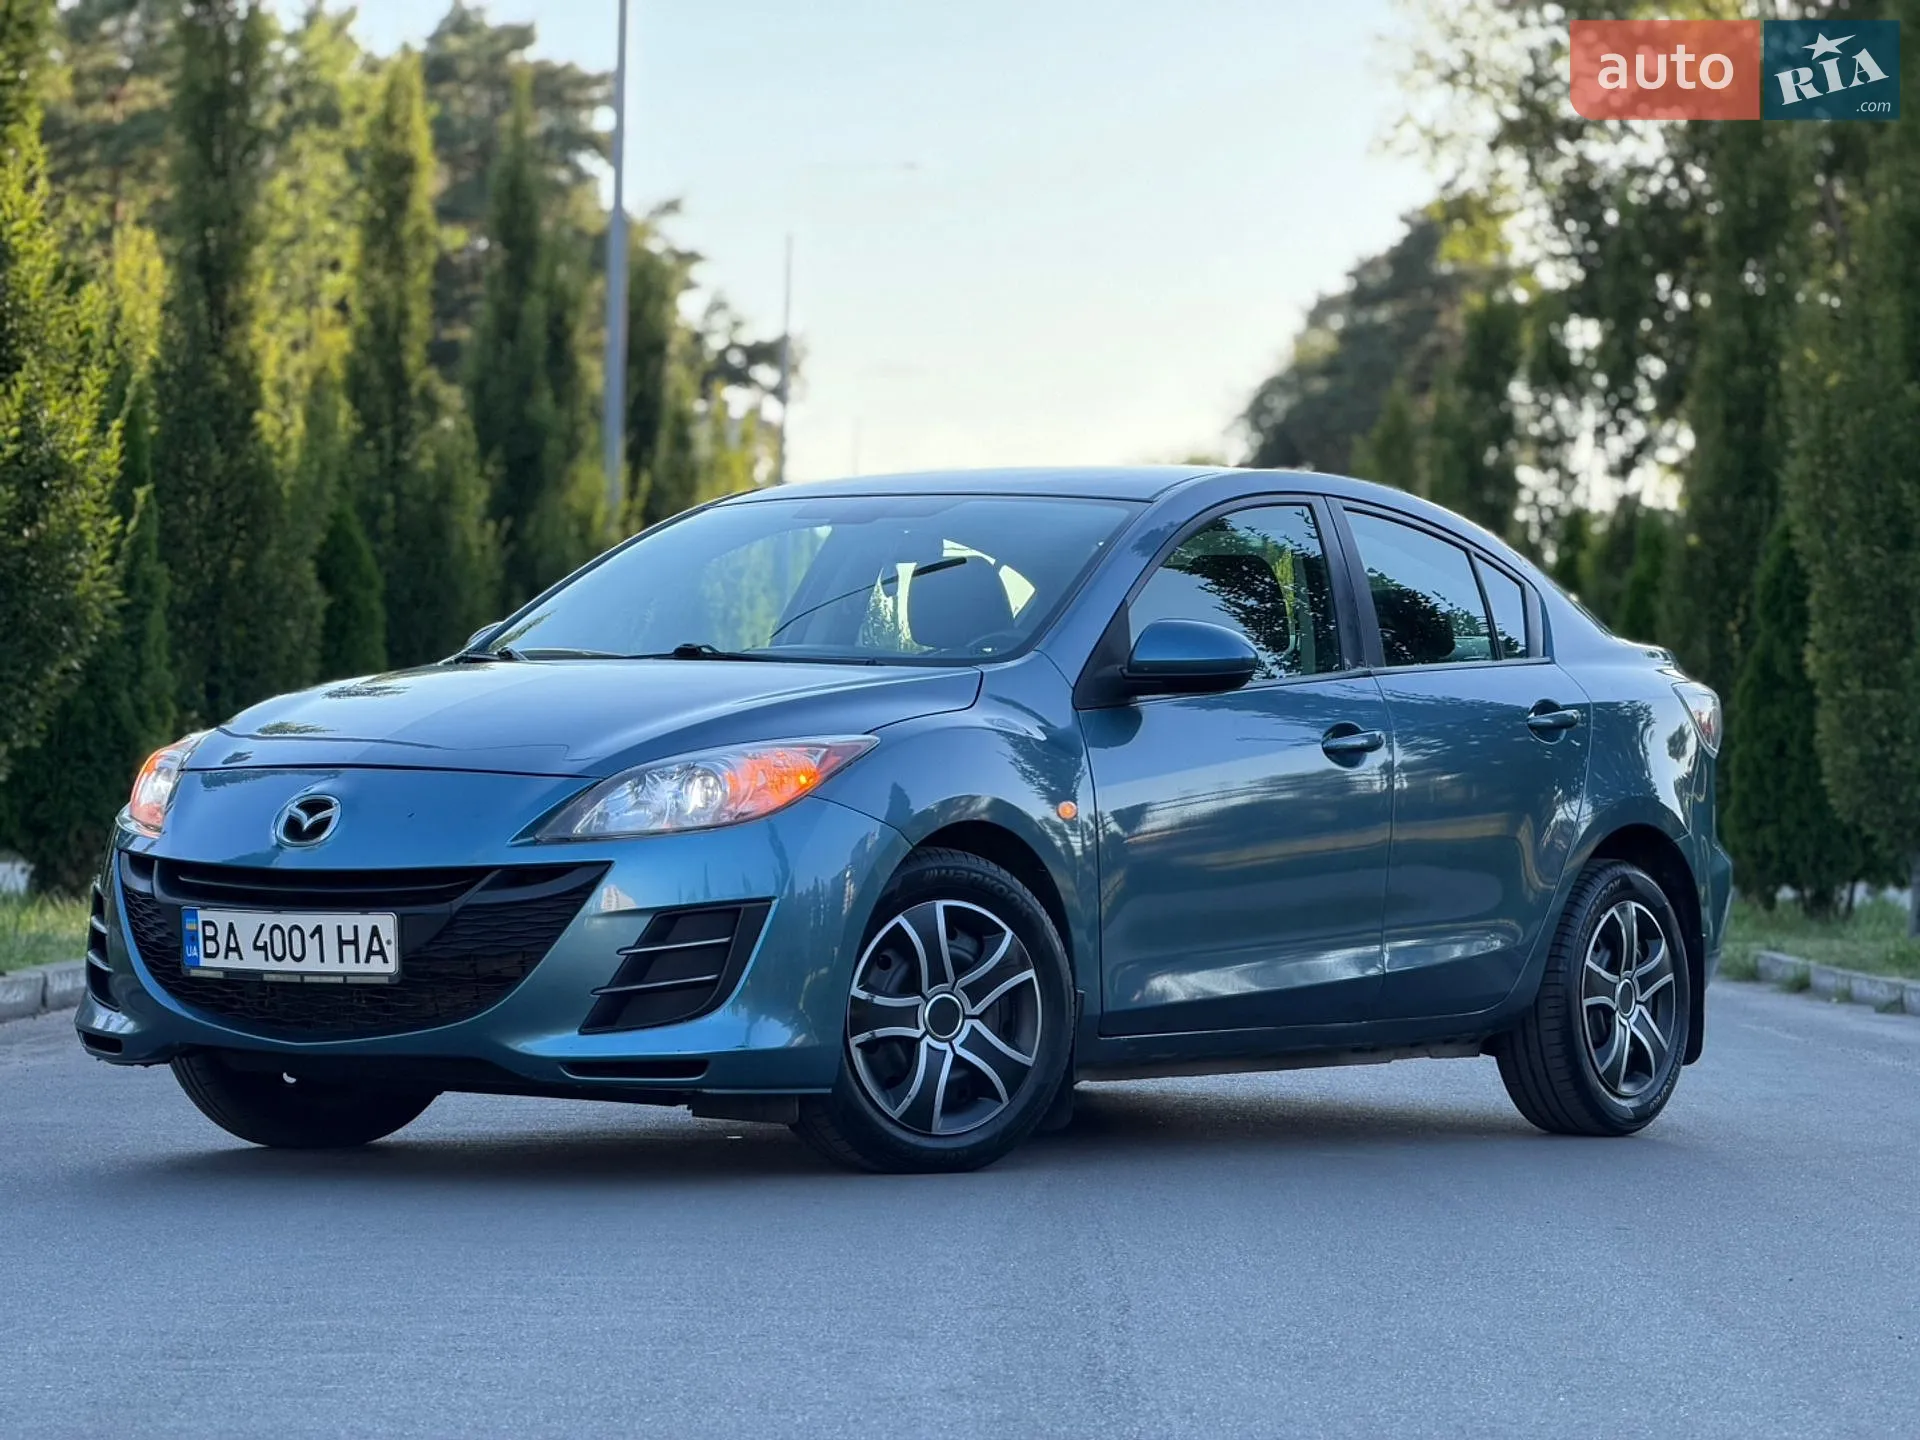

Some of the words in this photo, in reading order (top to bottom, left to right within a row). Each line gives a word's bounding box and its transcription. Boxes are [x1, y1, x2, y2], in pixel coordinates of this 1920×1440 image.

[186, 945, 198, 957] UA
[201, 920, 244, 960] BA
[252, 923, 325, 963] 4001
[336, 924, 389, 964] HA
